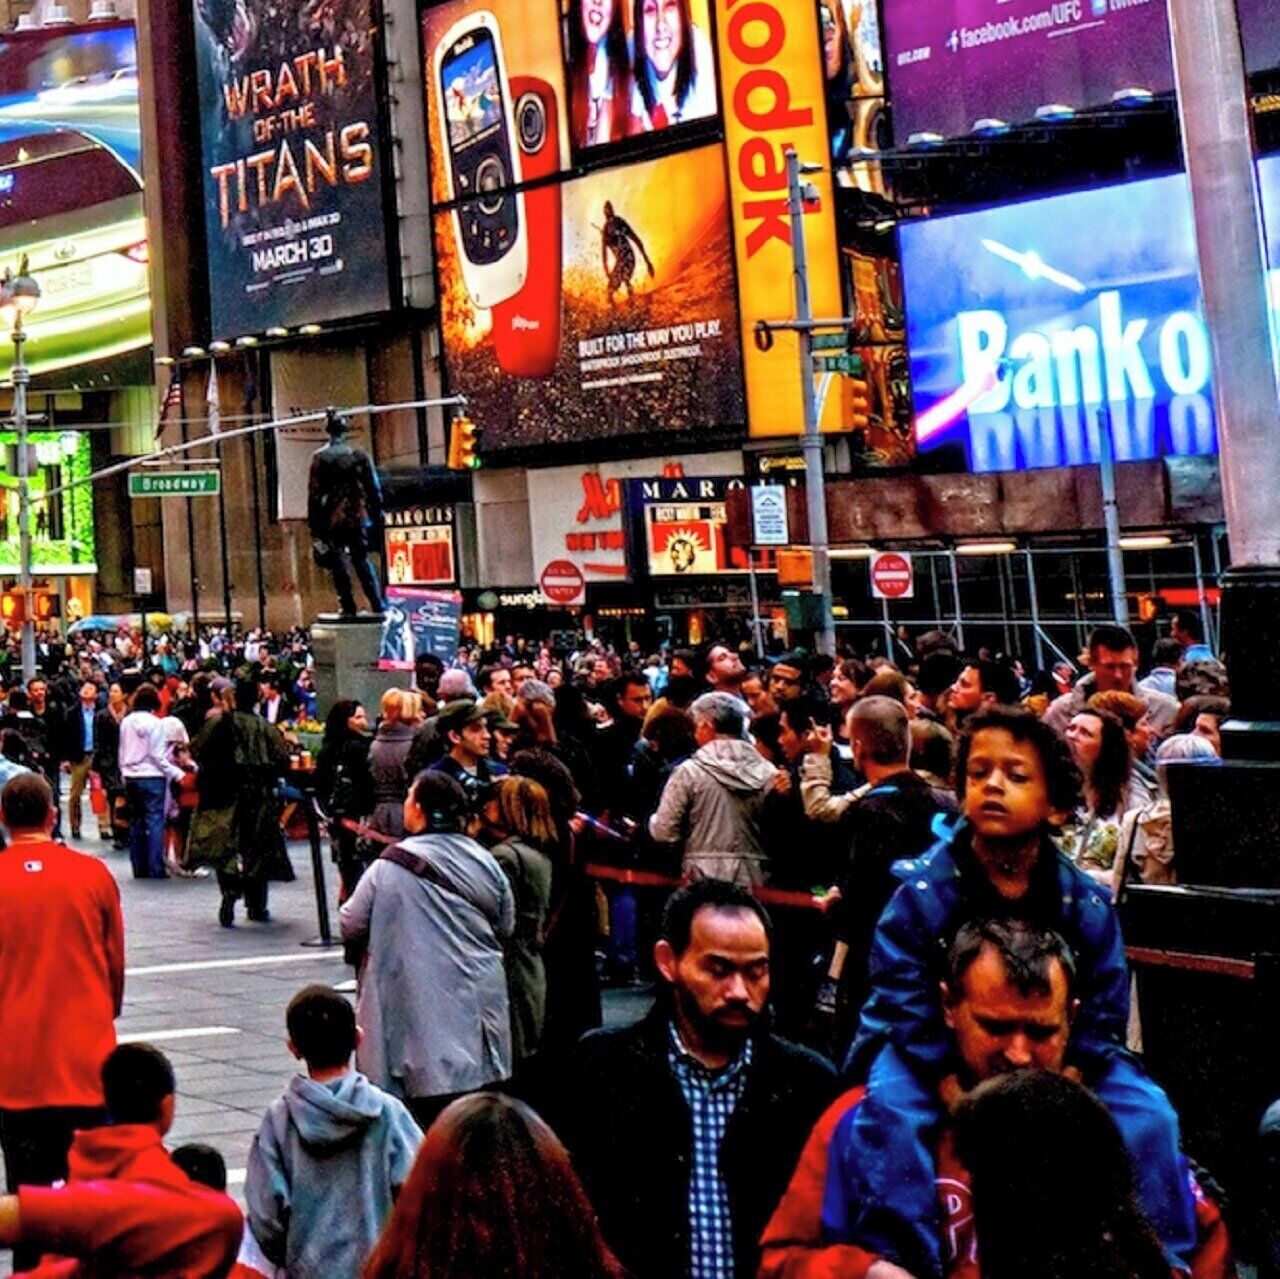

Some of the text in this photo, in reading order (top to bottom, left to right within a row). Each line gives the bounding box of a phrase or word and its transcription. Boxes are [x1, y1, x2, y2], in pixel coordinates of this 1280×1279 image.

[959, 0, 1083, 49] facebook.com/UFC
[223, 45, 346, 121] WRATH
[209, 119, 374, 228] TITANS
[252, 234, 333, 273] MARCH 30
[579, 319, 723, 358] BUILT FOR THE WAY YOU PLAY.
[143, 477, 207, 492] Broadway
[385, 507, 453, 526] MARQUIS
